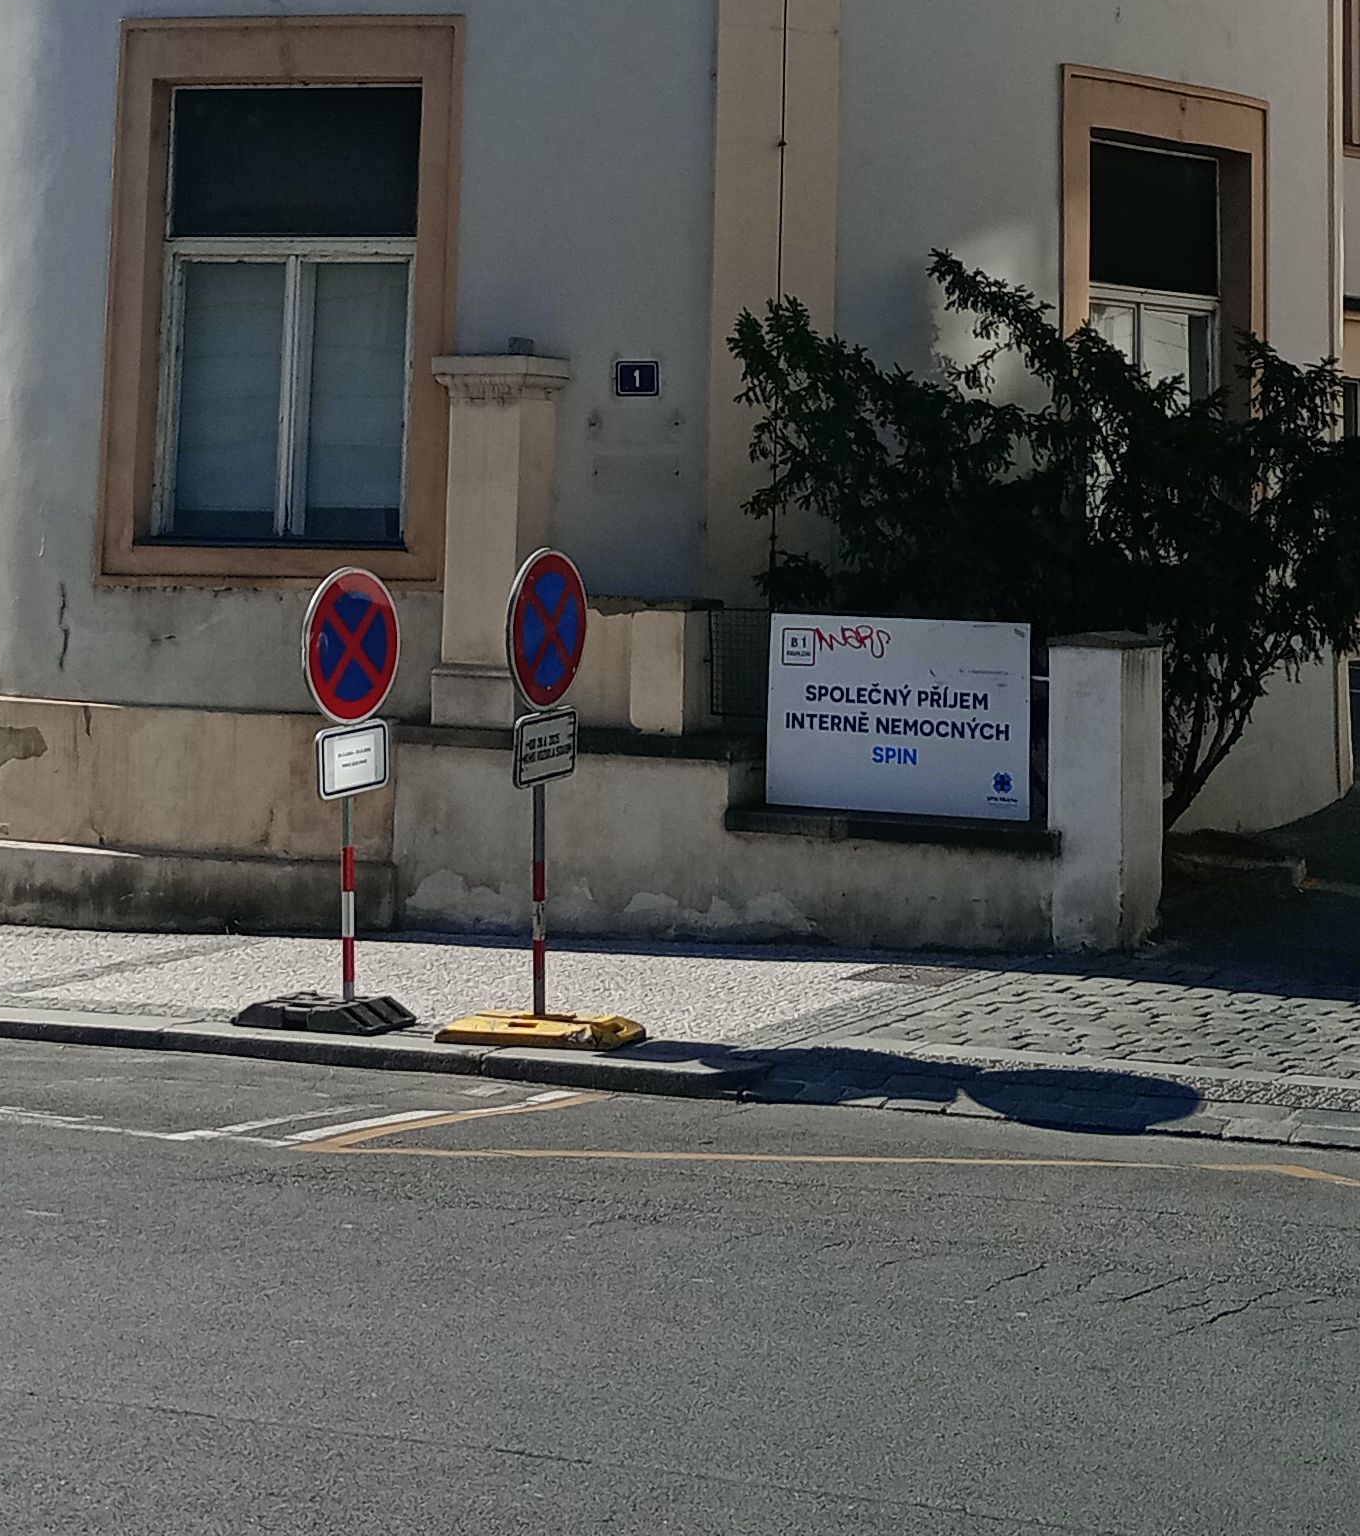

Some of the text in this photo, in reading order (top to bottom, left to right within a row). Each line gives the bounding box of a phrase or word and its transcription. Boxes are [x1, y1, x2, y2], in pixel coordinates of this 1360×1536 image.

[633, 369, 640, 388] 1
[791, 637, 798, 647] B
[805, 683, 989, 711] SPOLEČNÝ PŘÍJEM
[785, 711, 1010, 742] INTERNĚ NEMOCNÝCH
[872, 745, 918, 766] SPIN
